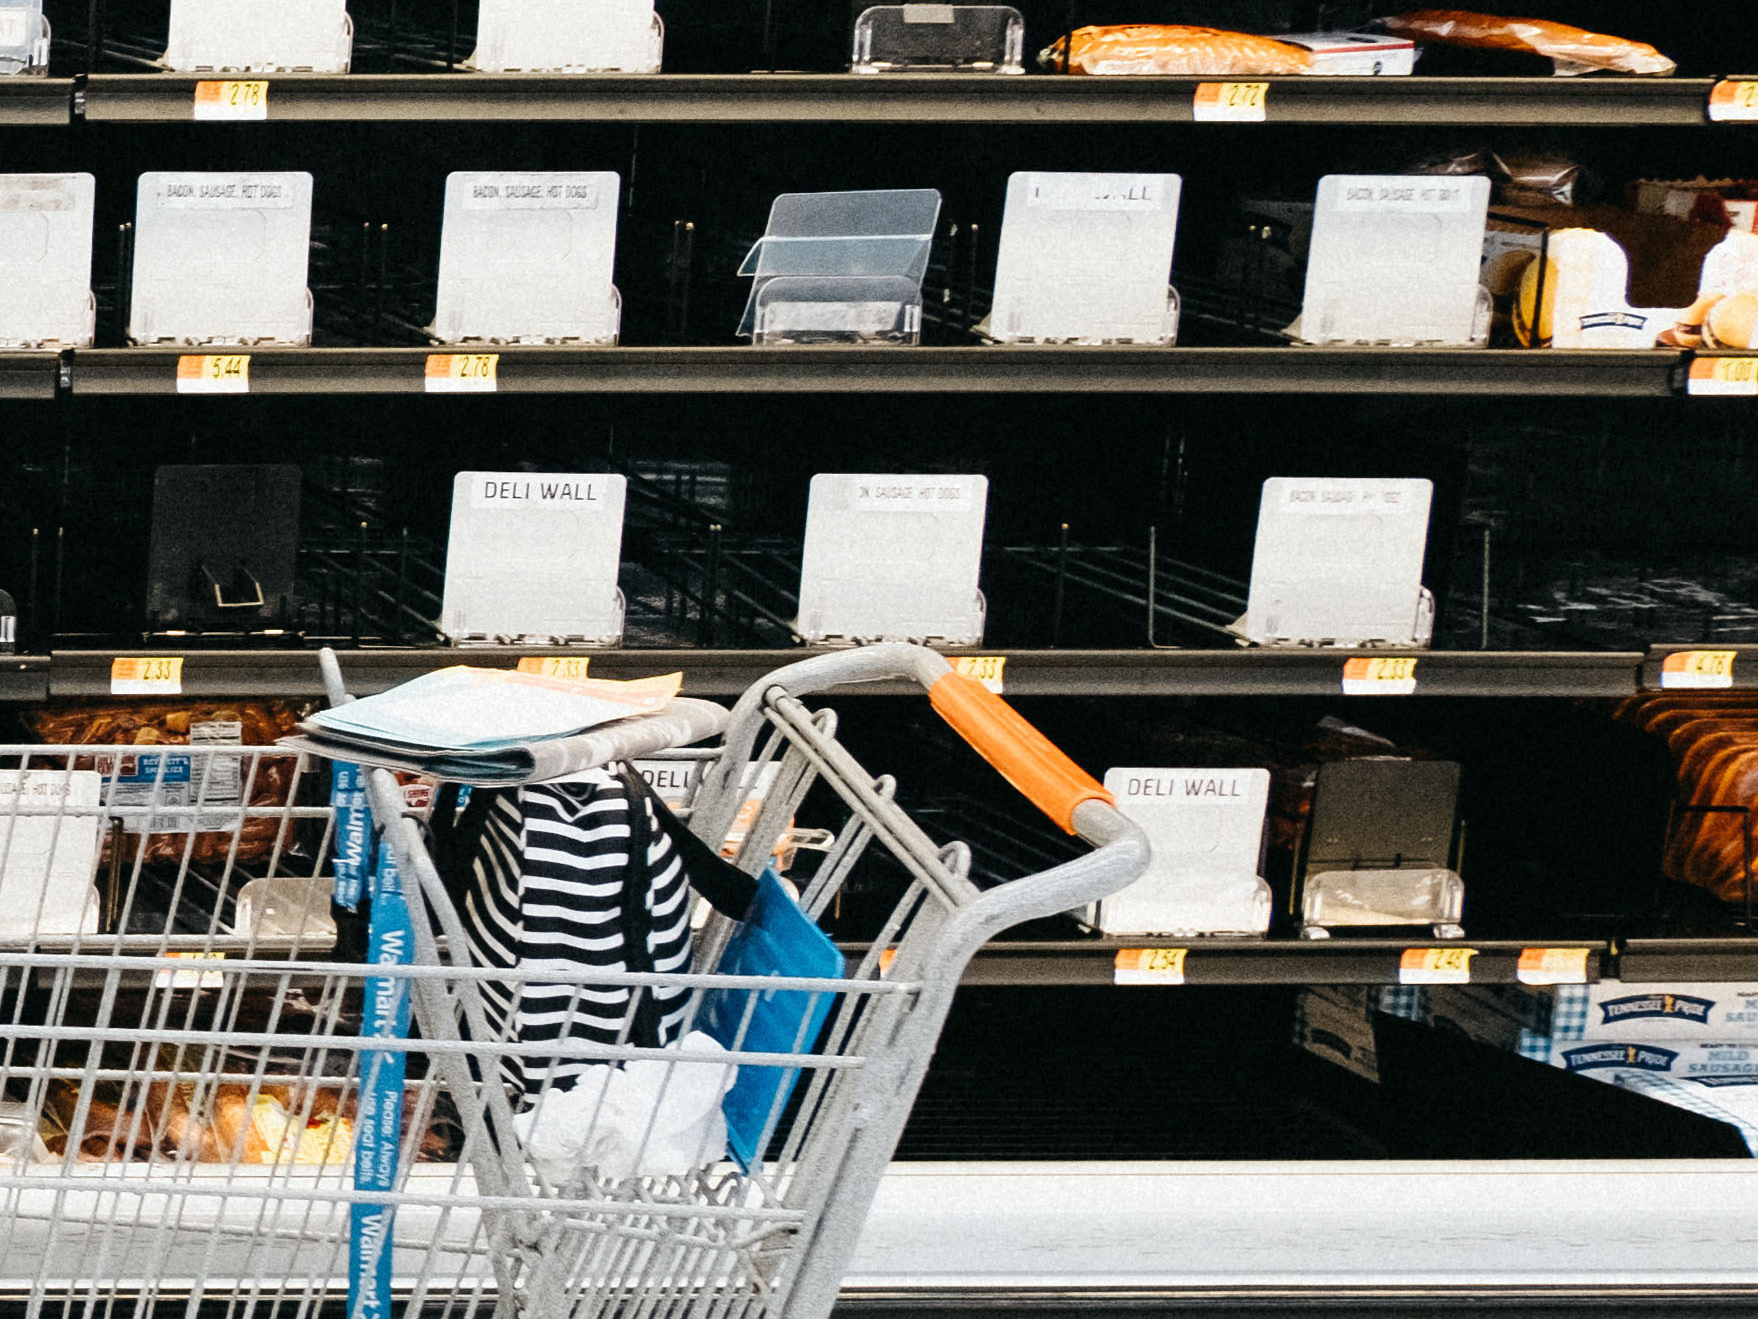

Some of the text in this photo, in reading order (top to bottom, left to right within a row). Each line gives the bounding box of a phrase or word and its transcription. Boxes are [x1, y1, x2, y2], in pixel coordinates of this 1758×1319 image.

[484, 480, 597, 502] DELI WALL
[1127, 777, 1241, 798] DELI WALL
[377, 1090, 398, 1188] Please: Always
